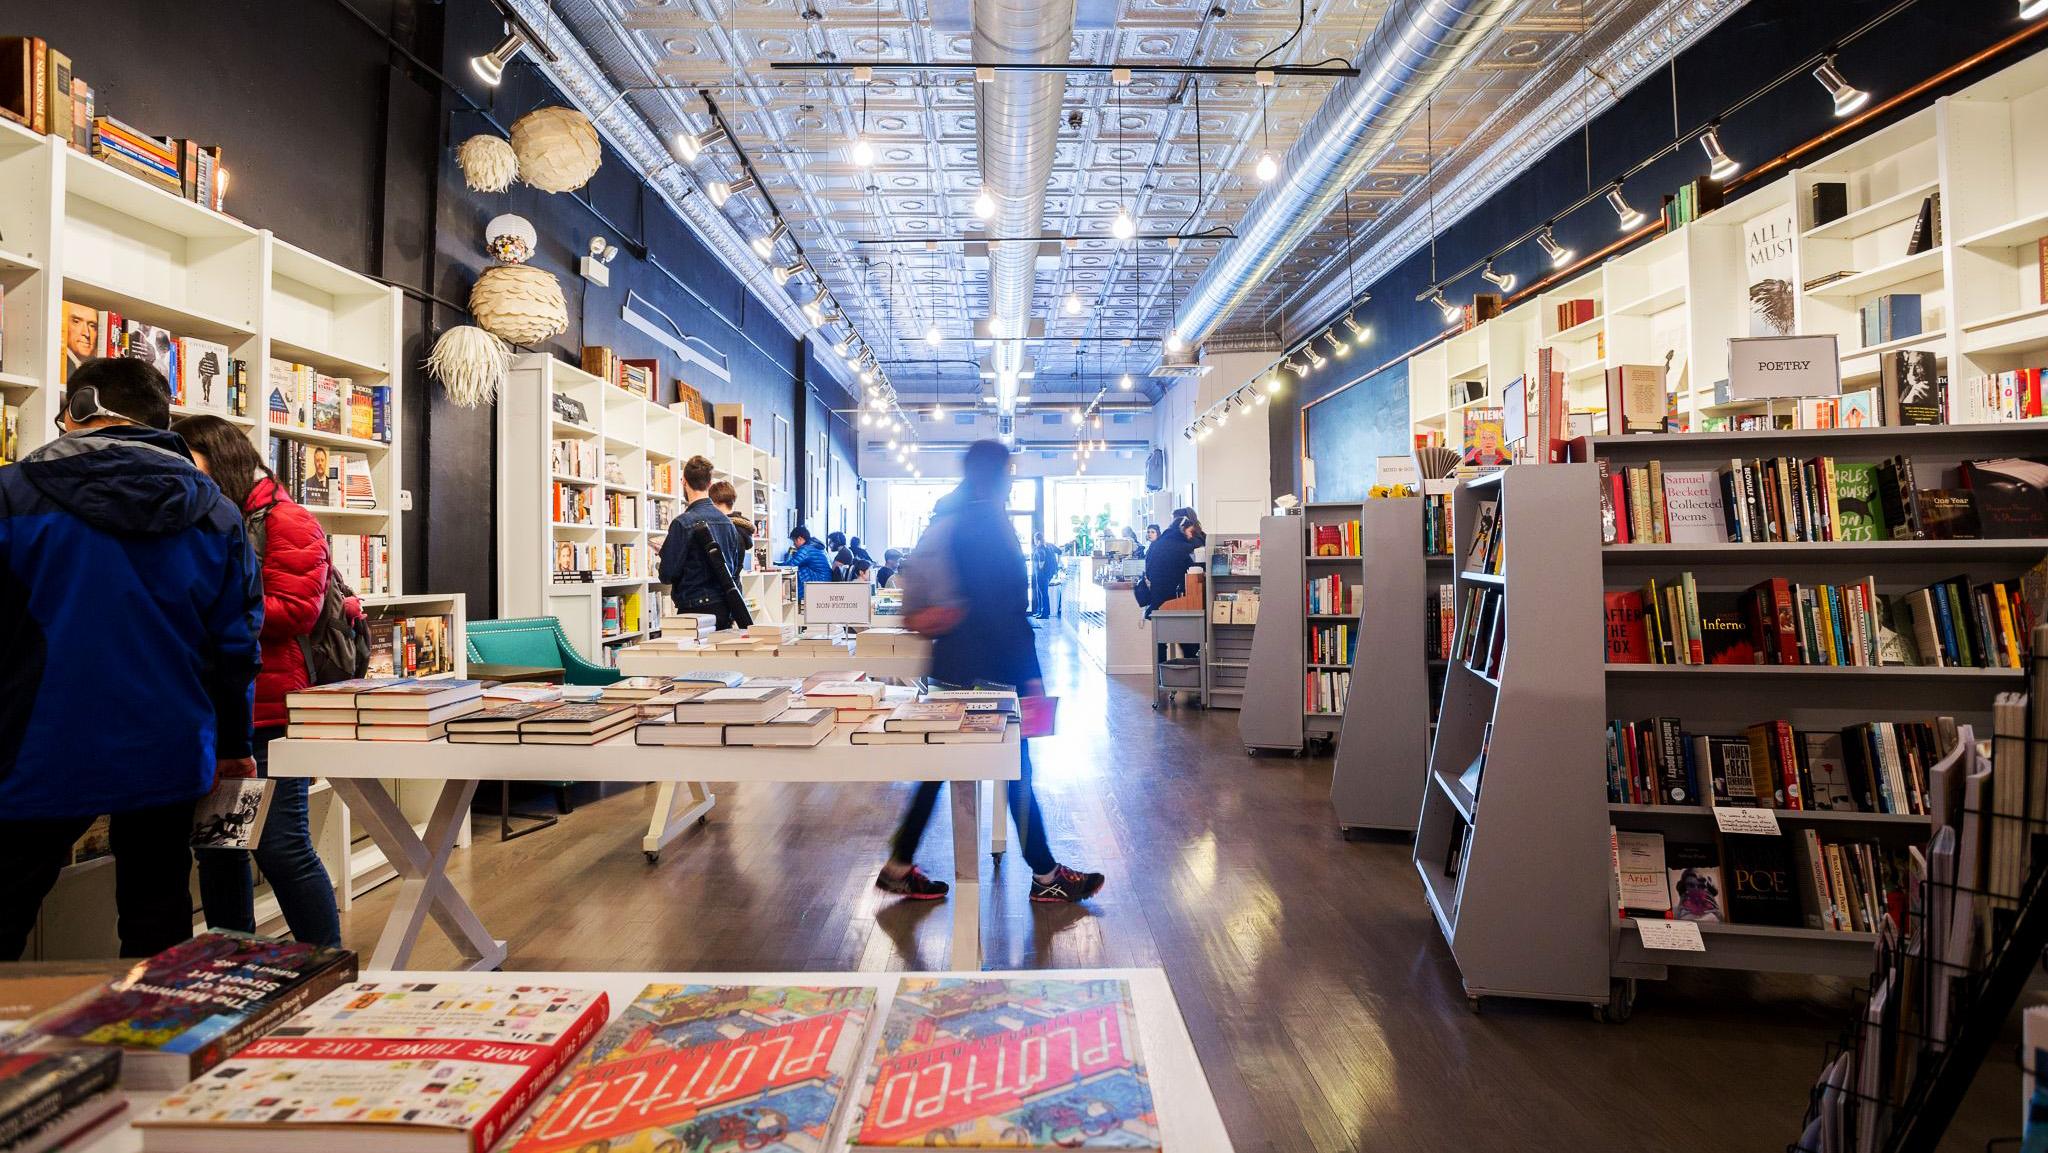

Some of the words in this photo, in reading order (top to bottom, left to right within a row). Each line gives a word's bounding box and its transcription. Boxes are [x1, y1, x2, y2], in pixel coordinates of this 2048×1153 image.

[1750, 224, 1778, 247] ALL
[1758, 360, 1811, 372] POETRY
[1665, 473, 1706, 485] Samuel
[1744, 467, 1753, 496] BEOWULF
[1834, 468, 1870, 484] ARLES
[1667, 486, 1710, 497] Beckett
[1669, 498, 1722, 509] Collected
[1950, 497, 1969, 505] Year
[1670, 511, 1707, 522] Poems
[1841, 526, 1873, 542] ATS
[1703, 619, 1746, 630] Inferno
[1663, 722, 1675, 755] american
[1723, 745, 1750, 759] WOMEN
[1664, 755, 1677, 779] poetry
[1729, 759, 1750, 777] BEAT
[1627, 873, 1654, 883] Ariel
[1735, 869, 1790, 893] POE
[186, 970, 221, 983] Art
[220, 974, 280, 992] Street
[111, 981, 213, 1003] Mammo
[188, 981, 213, 993] of
[213, 983, 266, 1000] Book
[212, 995, 249, 1010] The
[241, 1005, 282, 1038] Mammoth
[281, 993, 300, 1012] Book
[244, 1040, 309, 1056] THIS
[314, 1042, 373, 1057] LIKE
[372, 1042, 466, 1058] THINGS
[468, 1043, 537, 1062] MORE
[499, 1090, 528, 1131] MORE
[527, 1058, 558, 1099] THINGS
[559, 1038, 578, 1064] LIKE
[578, 1017, 595, 1044] THIS
